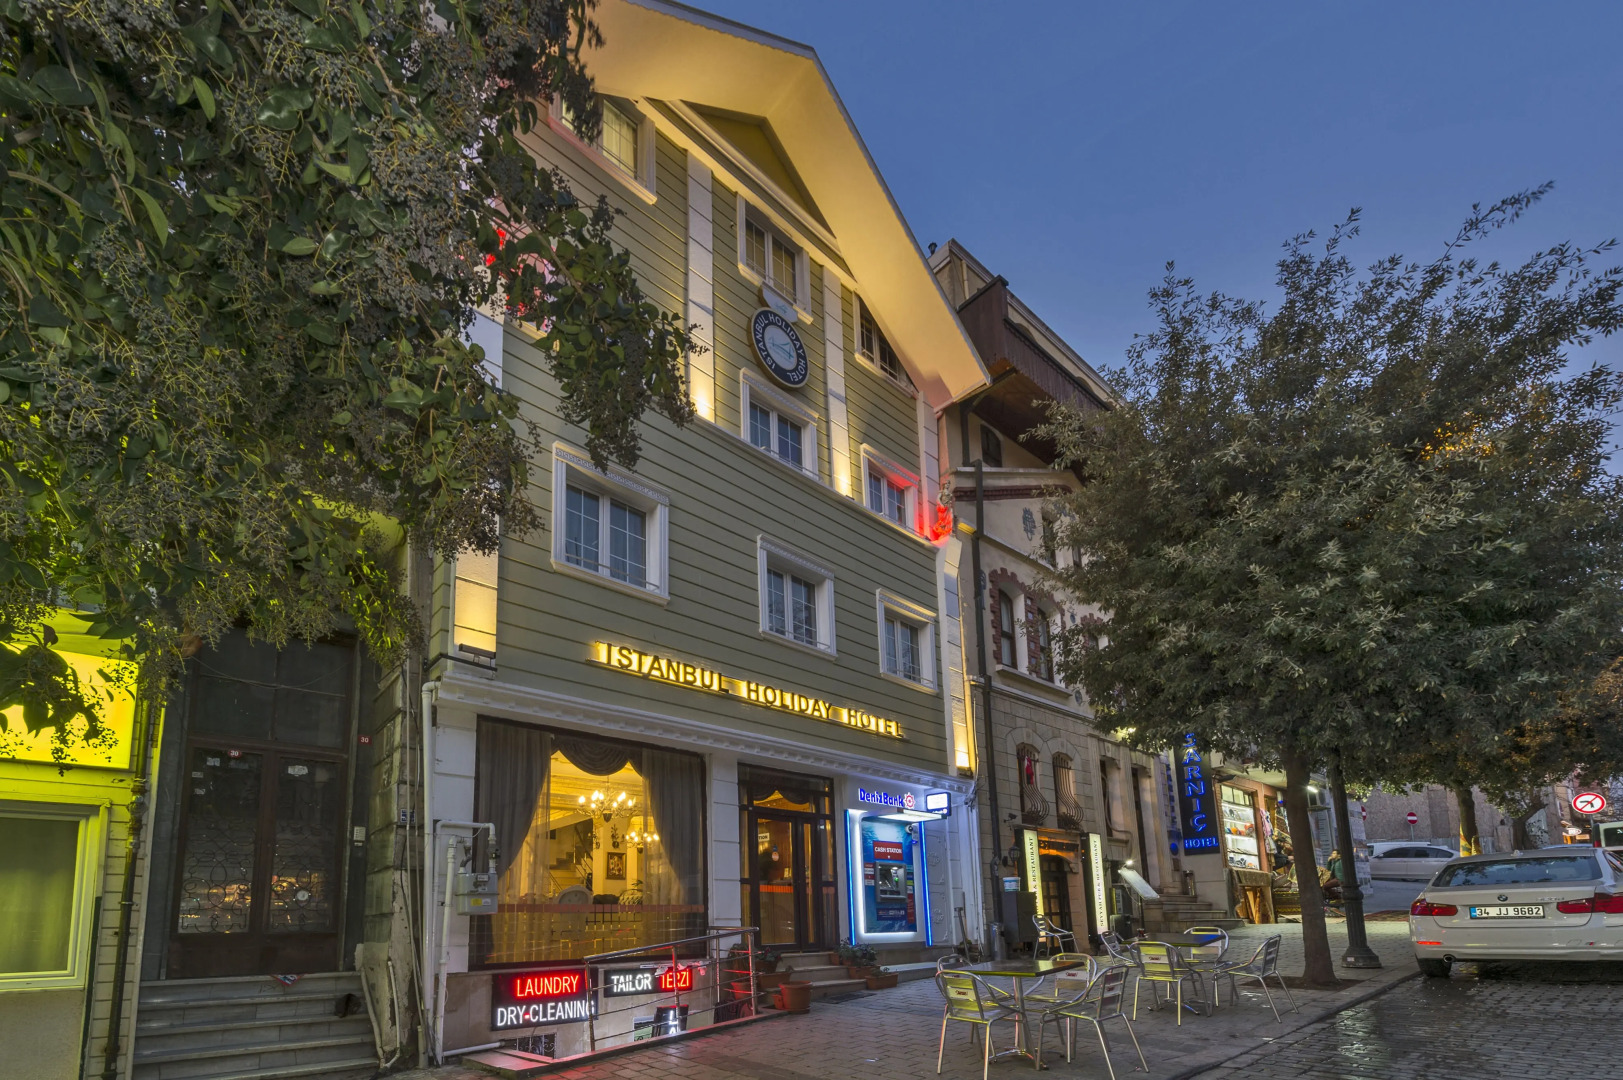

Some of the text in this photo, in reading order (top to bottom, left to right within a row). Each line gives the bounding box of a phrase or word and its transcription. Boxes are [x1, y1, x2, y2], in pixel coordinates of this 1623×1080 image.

[768, 312, 805, 357] HOLIDAY
[786, 357, 806, 382] HOTEL
[605, 642, 903, 738] ISTANBUL HOLIDAY HOTEL
[1182, 733, 1207, 832] SARNIÇ
[858, 788, 904, 808] DenizBank
[1184, 837, 1219, 848] HOTEL
[1092, 840, 1101, 881] RESTAURANT
[1476, 907, 1542, 916] 34 JJ 9682
[516, 975, 579, 997] LAUNDRY
[611, 974, 652, 992] TAILOR
[497, 1000, 594, 1026] DRY-CLEANING
